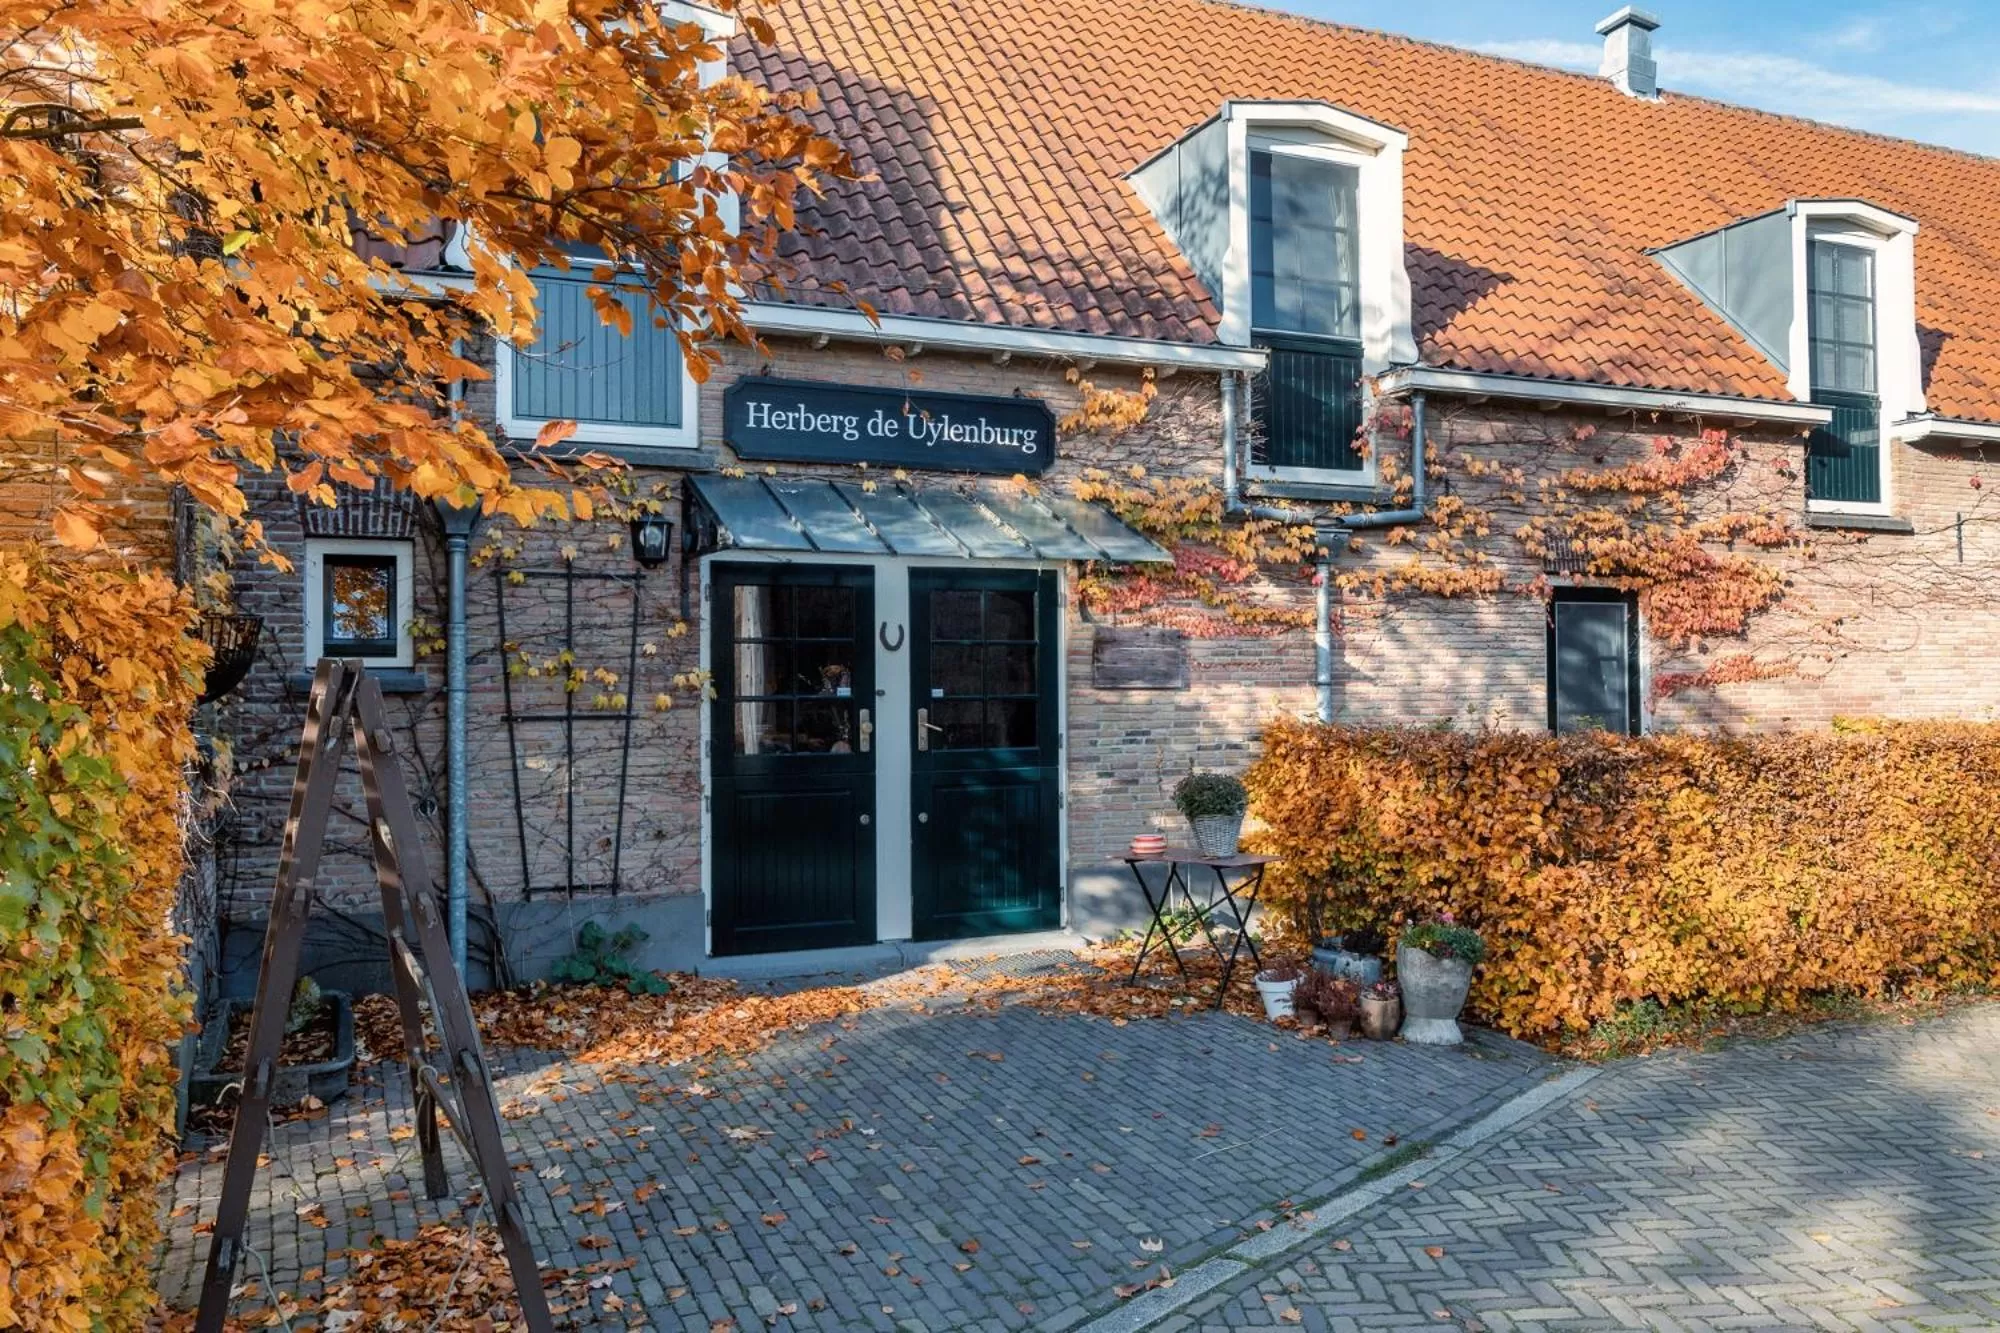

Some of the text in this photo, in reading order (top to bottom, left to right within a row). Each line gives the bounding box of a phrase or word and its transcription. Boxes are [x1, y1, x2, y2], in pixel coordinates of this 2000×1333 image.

[745, 401, 1037, 454] Herberg de Uylenburg
